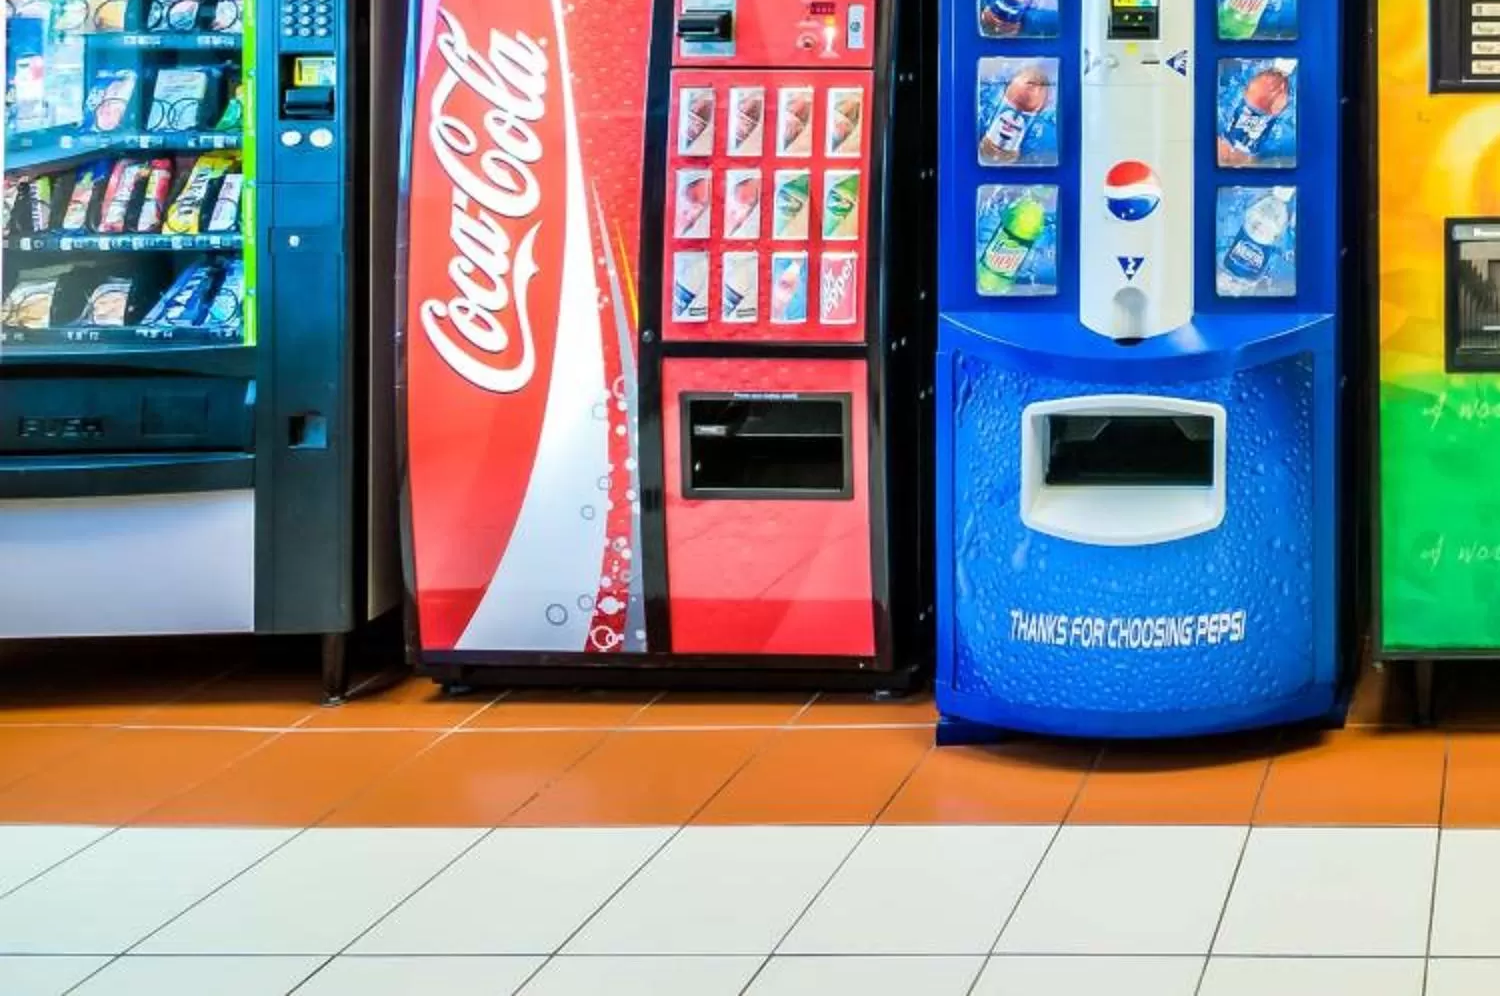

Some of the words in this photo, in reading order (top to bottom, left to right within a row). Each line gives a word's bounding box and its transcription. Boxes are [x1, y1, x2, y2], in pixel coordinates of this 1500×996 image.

[420, 5, 549, 395] Coca-Cola
[1010, 608, 1068, 645] THANKS
[1070, 615, 1105, 648] FOR
[1106, 614, 1196, 649] CHOOSING
[1195, 609, 1248, 646] PEPSI
